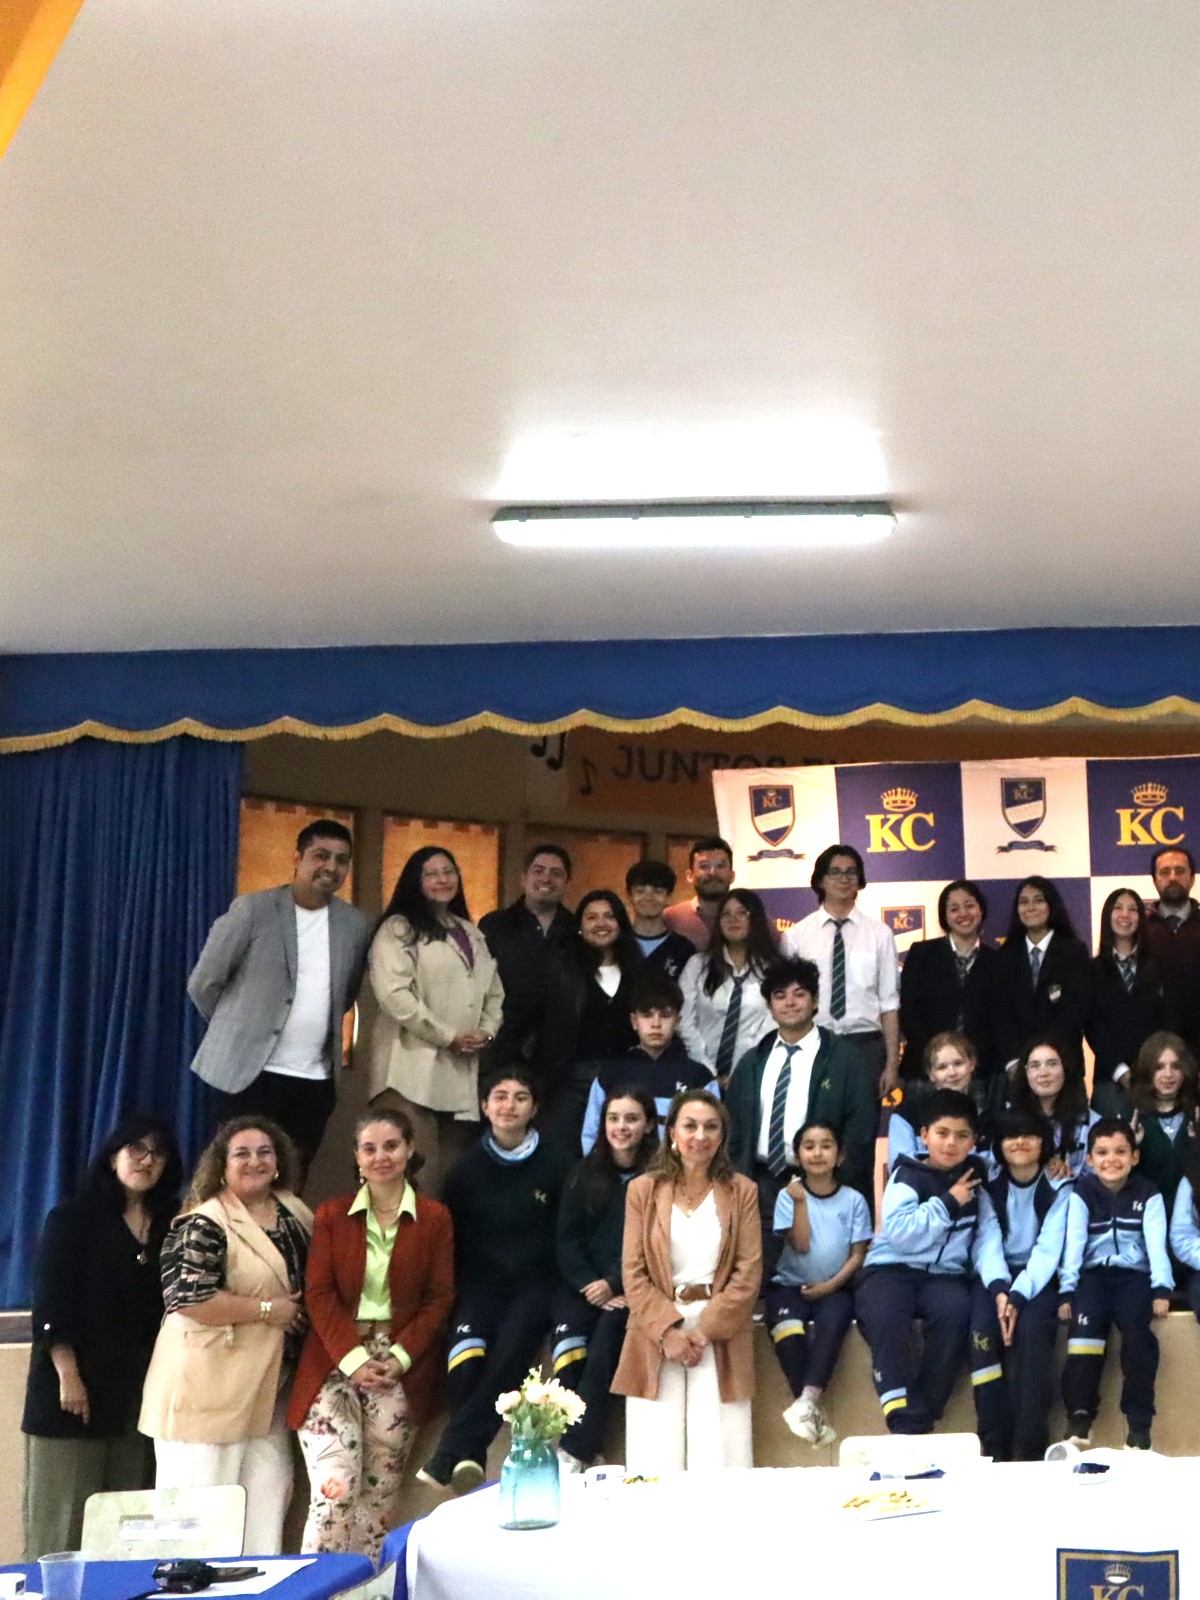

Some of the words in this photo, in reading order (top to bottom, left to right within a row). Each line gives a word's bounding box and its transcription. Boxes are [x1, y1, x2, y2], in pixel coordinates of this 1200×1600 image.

[866, 811, 936, 853] KC
[1117, 805, 1185, 846] KC
[894, 917, 914, 929] KC
